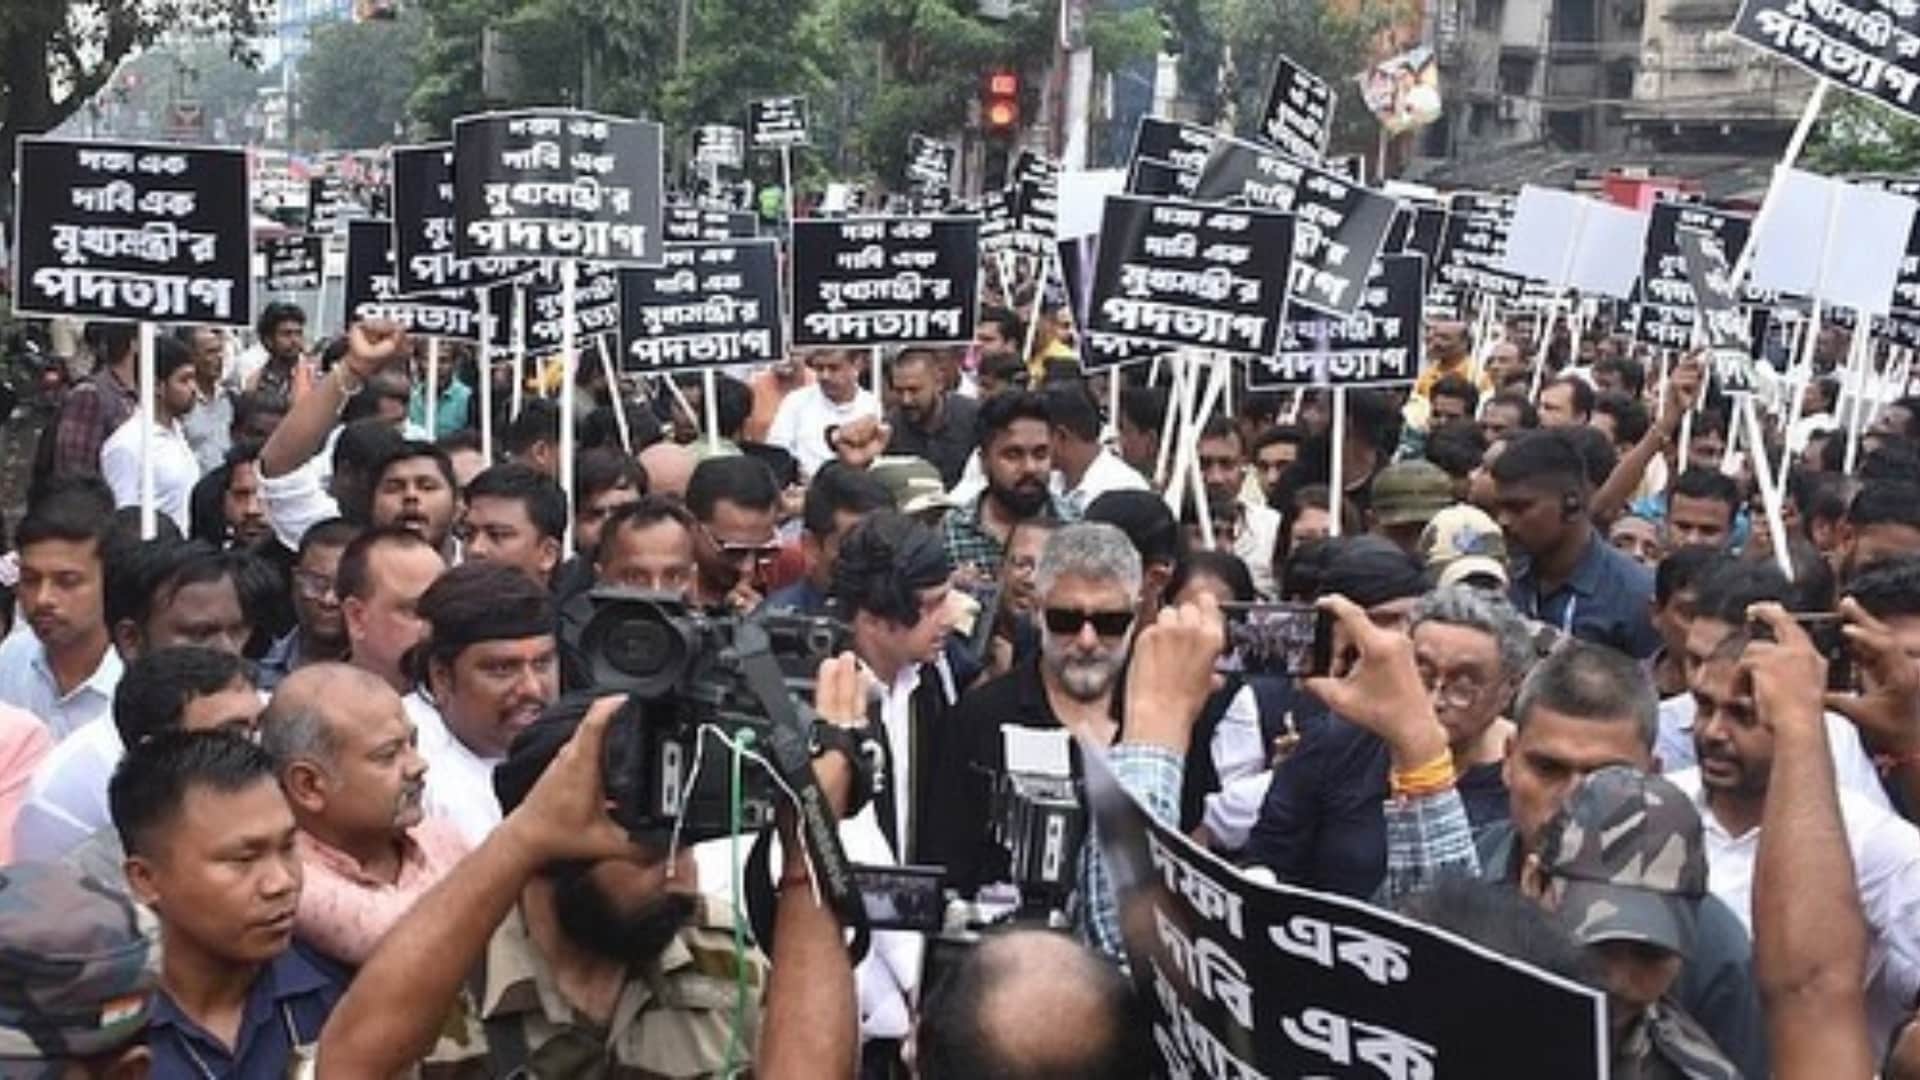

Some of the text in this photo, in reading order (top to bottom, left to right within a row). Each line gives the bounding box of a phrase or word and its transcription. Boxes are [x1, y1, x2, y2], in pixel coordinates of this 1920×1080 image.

[1755, 10, 1920, 104] পদত্যাগ
[71, 180, 196, 216] দাবি এক
[467, 218, 647, 256] পদত্যাগ
[33, 267, 234, 318] পদত্যাগ
[631, 329, 771, 364] পদত্যাগ
[804, 309, 962, 339] পদত্যাগ
[1102, 297, 1268, 349] পদত্যাগ
[1269, 915, 1411, 985] এক
[1152, 902, 1438, 1080] দাবি এক
